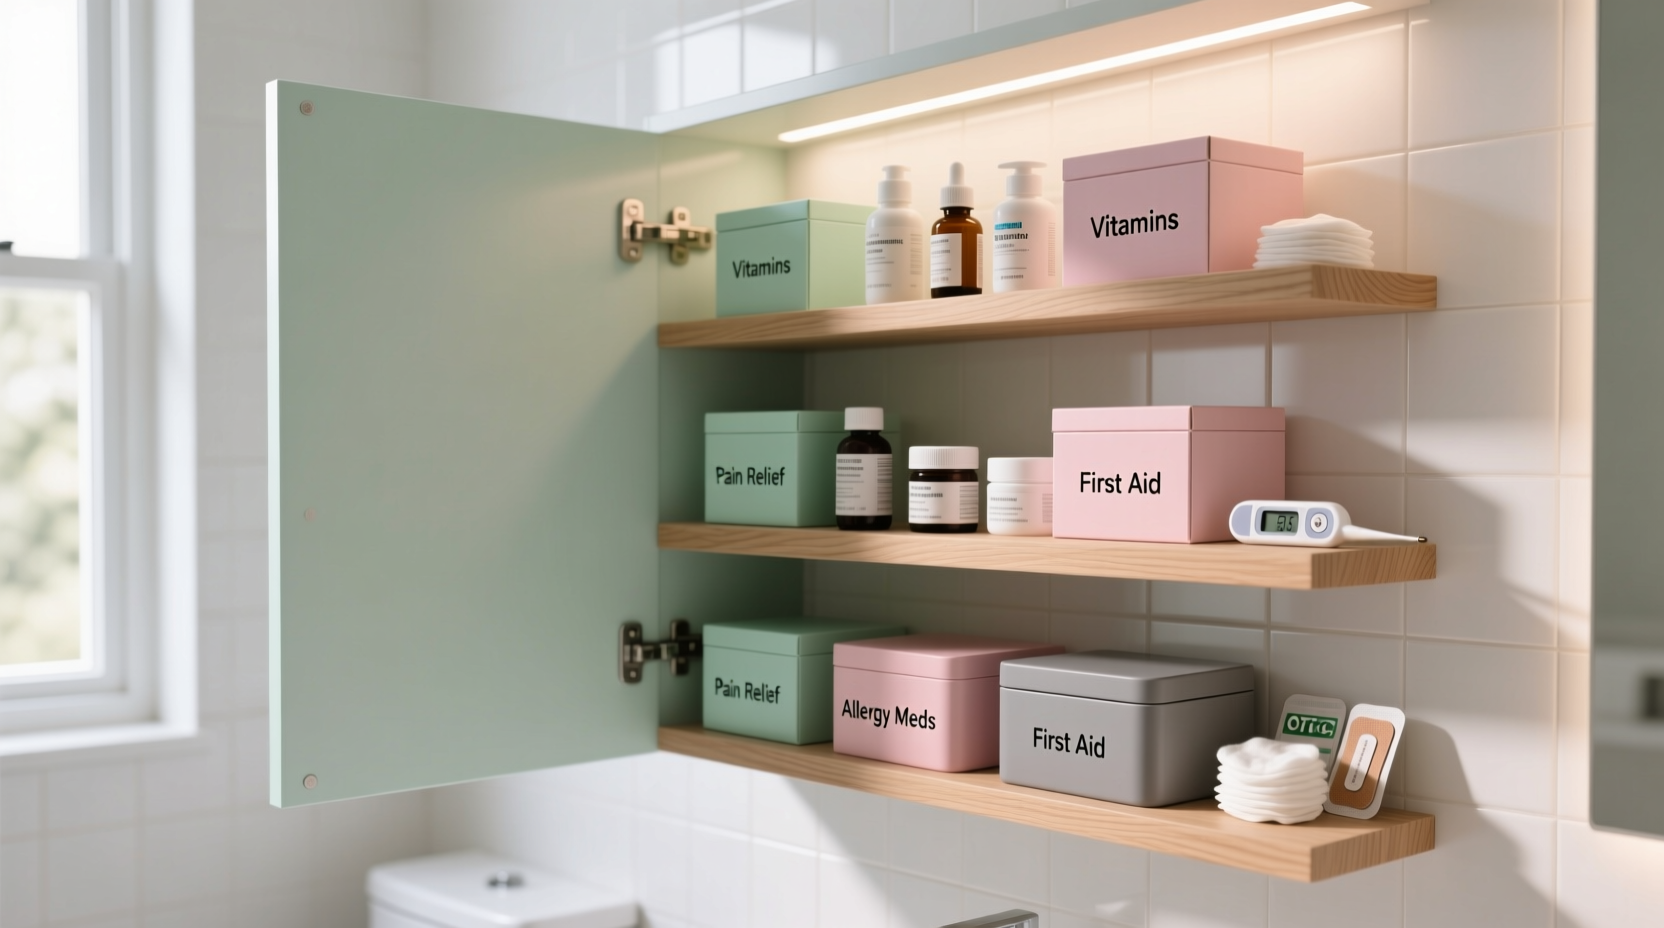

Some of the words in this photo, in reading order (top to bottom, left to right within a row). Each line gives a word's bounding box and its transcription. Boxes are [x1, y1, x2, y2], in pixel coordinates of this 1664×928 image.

[1090, 209, 1179, 239] Vitamins
[732, 256, 791, 279] Vitamins
[715, 466, 743, 486] Pain
[746, 466, 786, 487] Relief
[1080, 471, 1122, 494] First
[1127, 471, 1161, 495] Aid
[714, 677, 741, 699] Pain
[745, 681, 781, 704] Relief
[841, 698, 890, 729] Allergy
[895, 706, 936, 731] Meds
[1033, 727, 1071, 754] First
[1075, 733, 1106, 759] Aid
